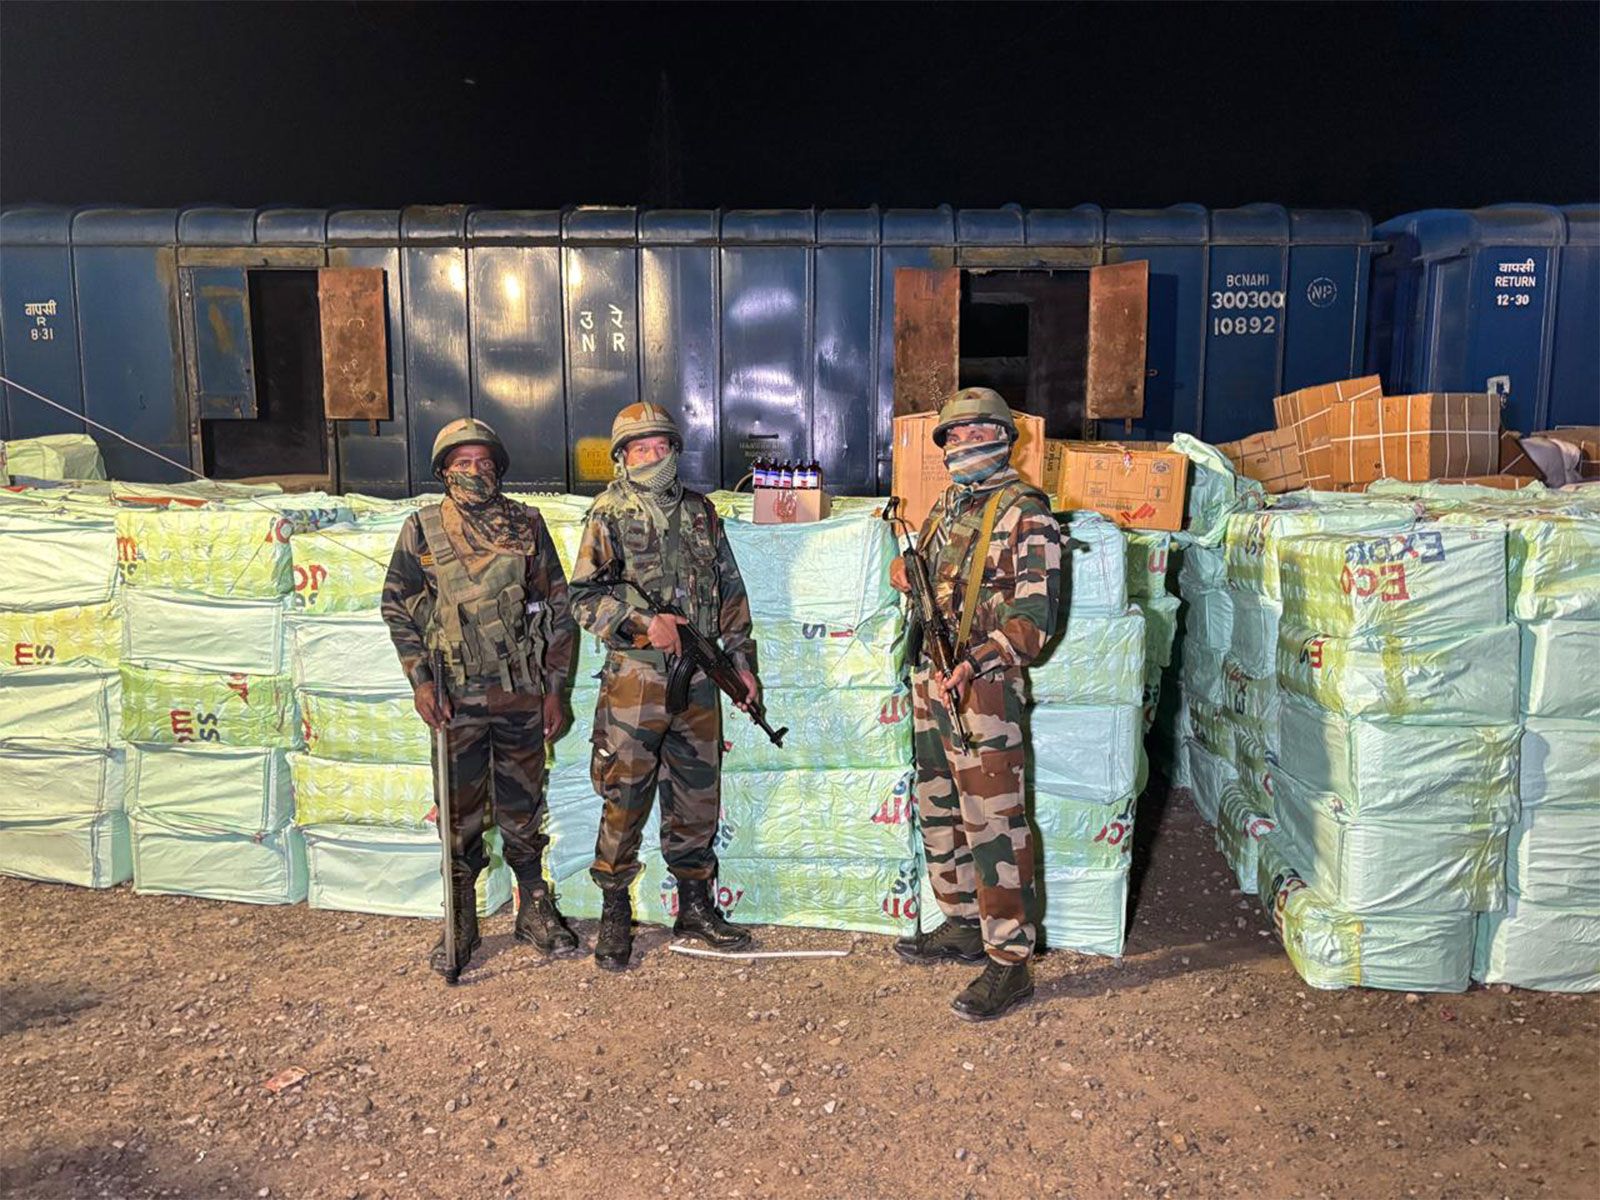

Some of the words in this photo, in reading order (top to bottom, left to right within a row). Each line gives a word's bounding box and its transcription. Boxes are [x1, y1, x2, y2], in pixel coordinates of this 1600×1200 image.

[1498, 258, 1535, 272] वापसी
[1494, 275, 1536, 287] RETURN
[1211, 290, 1286, 309] 300300
[1496, 294, 1530, 306] 12-30
[24, 299, 57, 316] वापसी
[36, 316, 47, 327] R
[1213, 316, 1276, 336] 10892
[582, 333, 596, 352] N
[613, 332, 626, 352] R
